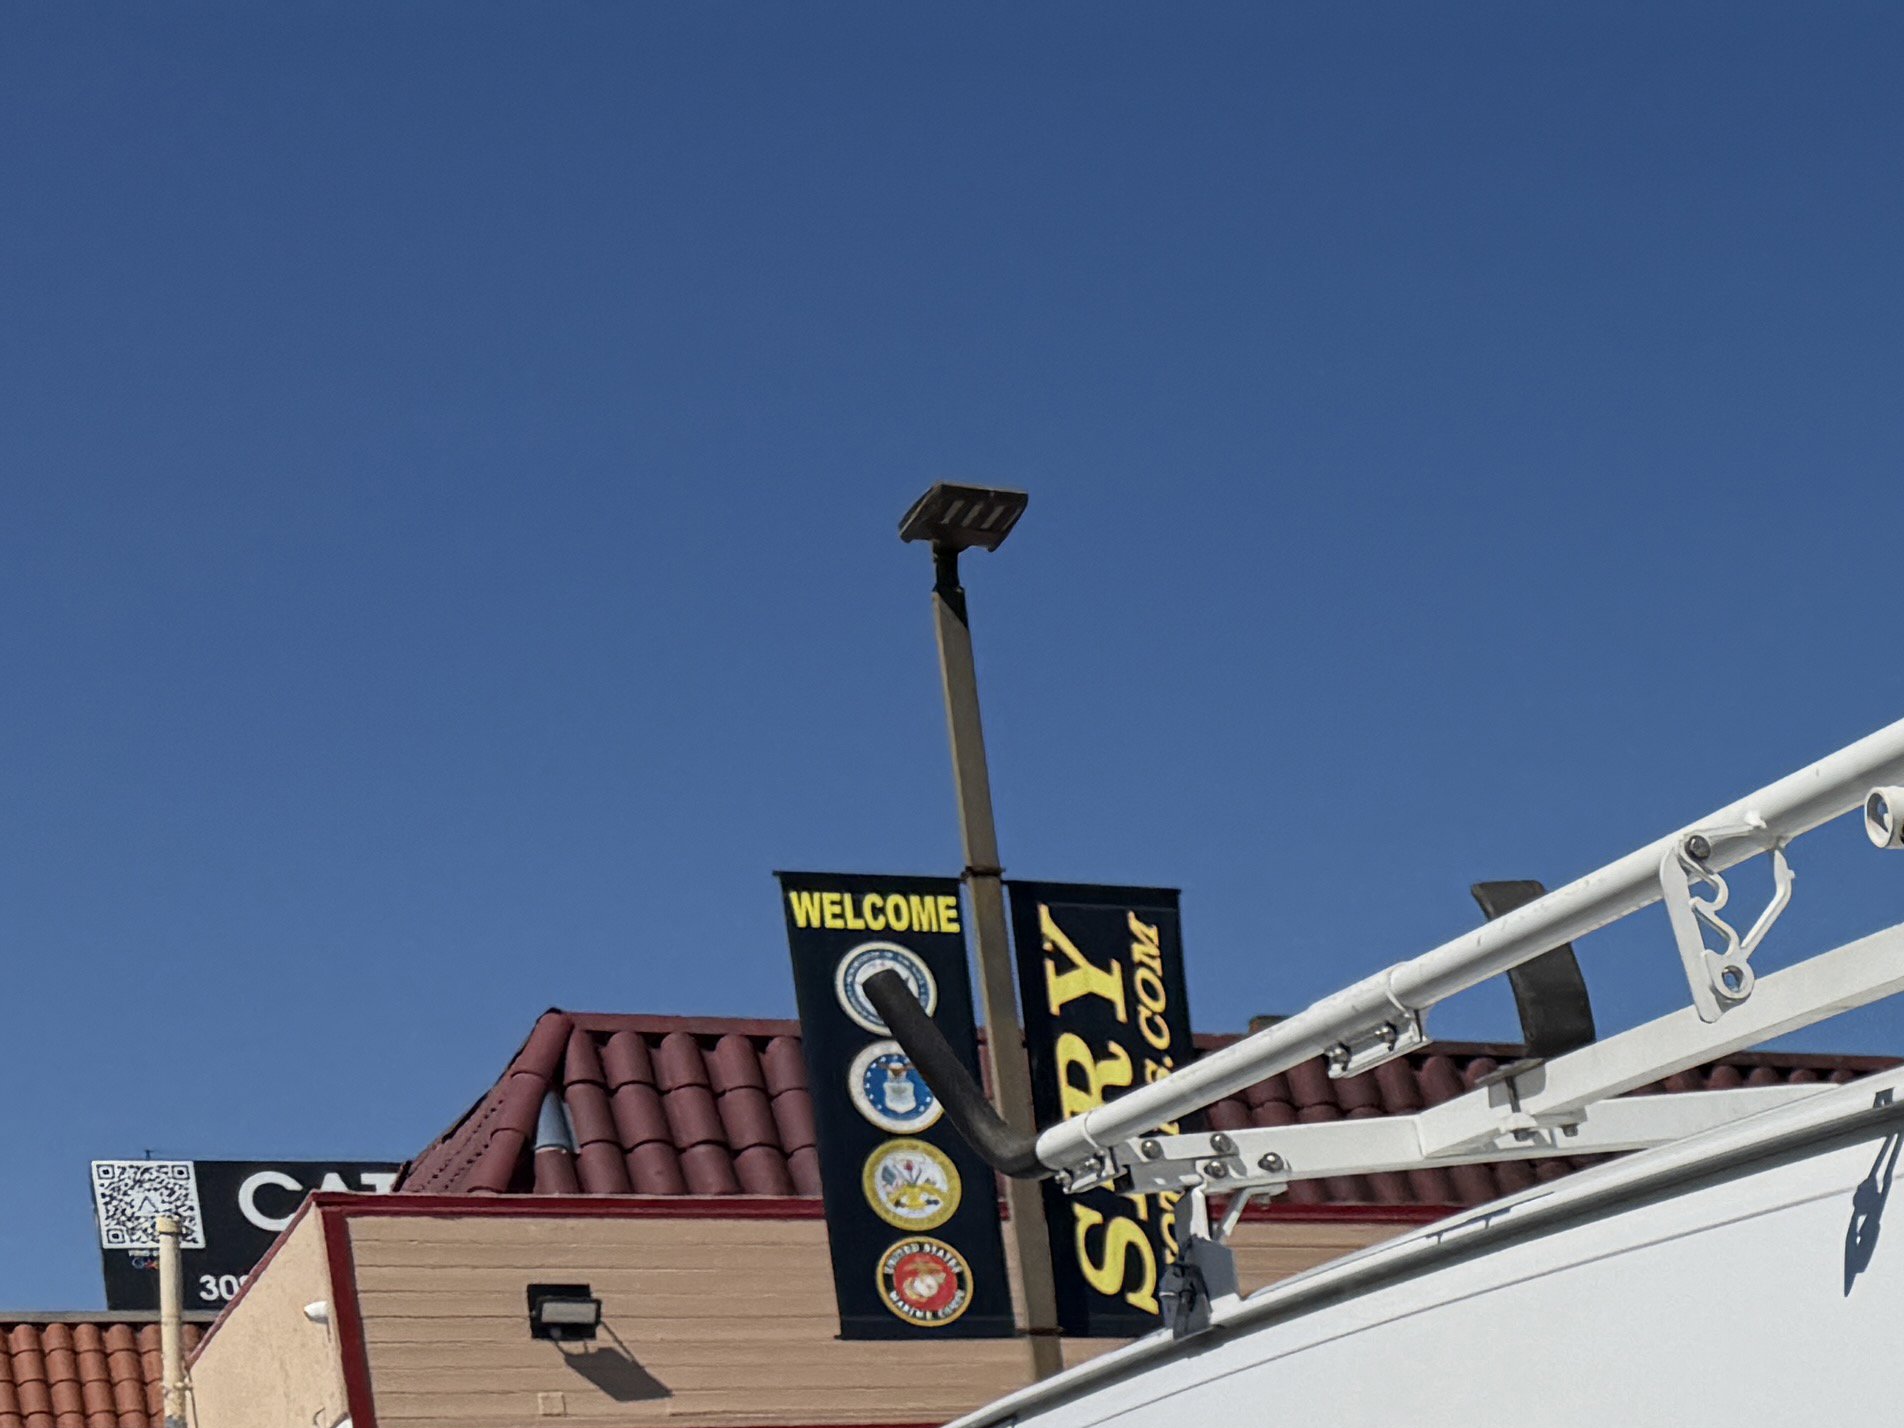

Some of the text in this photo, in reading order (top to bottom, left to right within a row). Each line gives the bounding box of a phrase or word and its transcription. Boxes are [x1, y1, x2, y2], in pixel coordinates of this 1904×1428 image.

[789, 891, 960, 933] WELCOME
[1037, 903, 1160, 1316] SRY
[199, 1274, 249, 1301] 30
